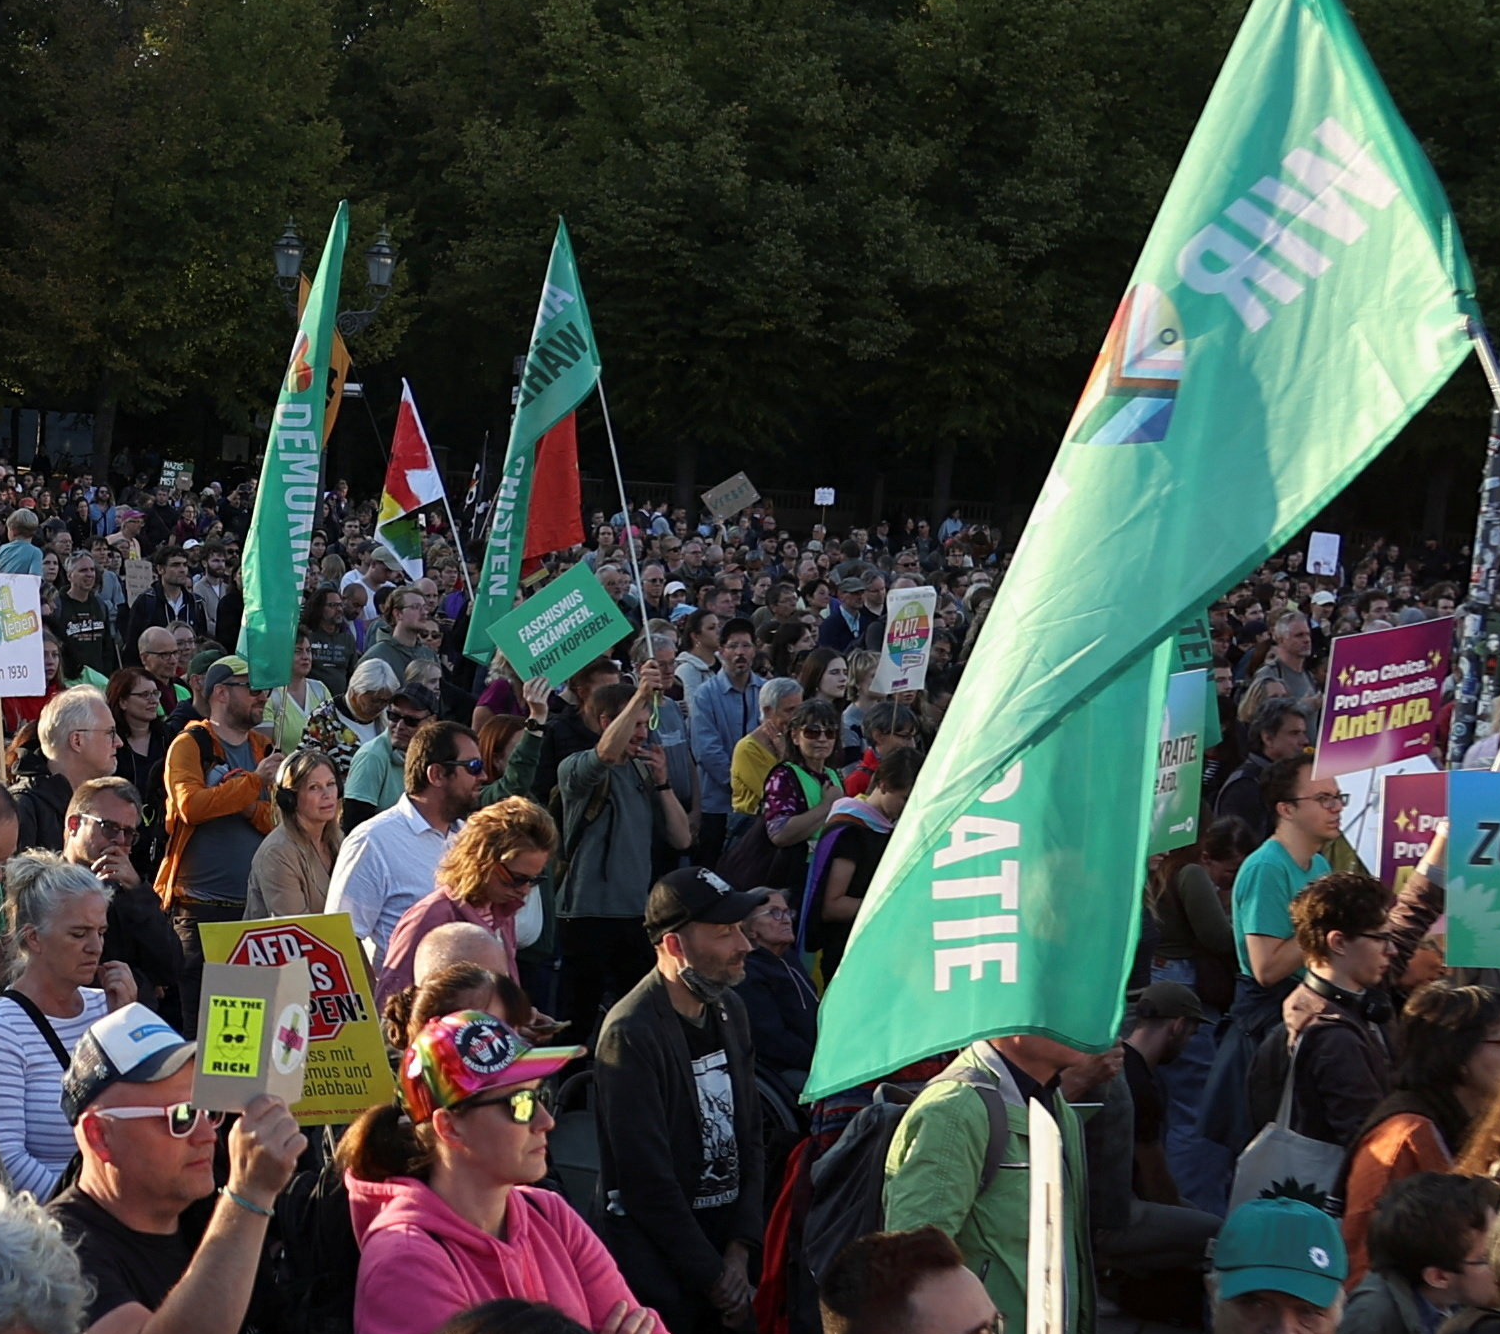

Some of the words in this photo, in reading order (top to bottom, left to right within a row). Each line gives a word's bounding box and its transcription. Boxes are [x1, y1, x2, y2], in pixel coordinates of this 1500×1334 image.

[164, 459, 184, 470] NAZIS
[4, 615, 36, 637] leben
[518, 588, 584, 644] FASCHISMUS
[528, 604, 594, 658] BEKÄMPFEN.
[893, 617, 920, 638] PLATZ
[527, 650, 562, 677] NICHT
[559, 611, 614, 657] KOPIEREN.
[8, 665, 29, 679] 1930
[1353, 668, 1379, 686] Pro
[1380, 659, 1427, 680] Choice.
[1334, 694, 1360, 711] Pro
[1360, 677, 1438, 707] Demokratie.
[1328, 706, 1387, 743] Anti
[246, 933, 315, 967] AFD-
[212, 998, 236, 1009] TAX
[240, 1001, 263, 1011] THE
[330, 1045, 355, 1062] mit
[212, 1061, 250, 1074] RICH
[344, 1062, 373, 1079] und
[304, 1079, 368, 1098] alabbau!
